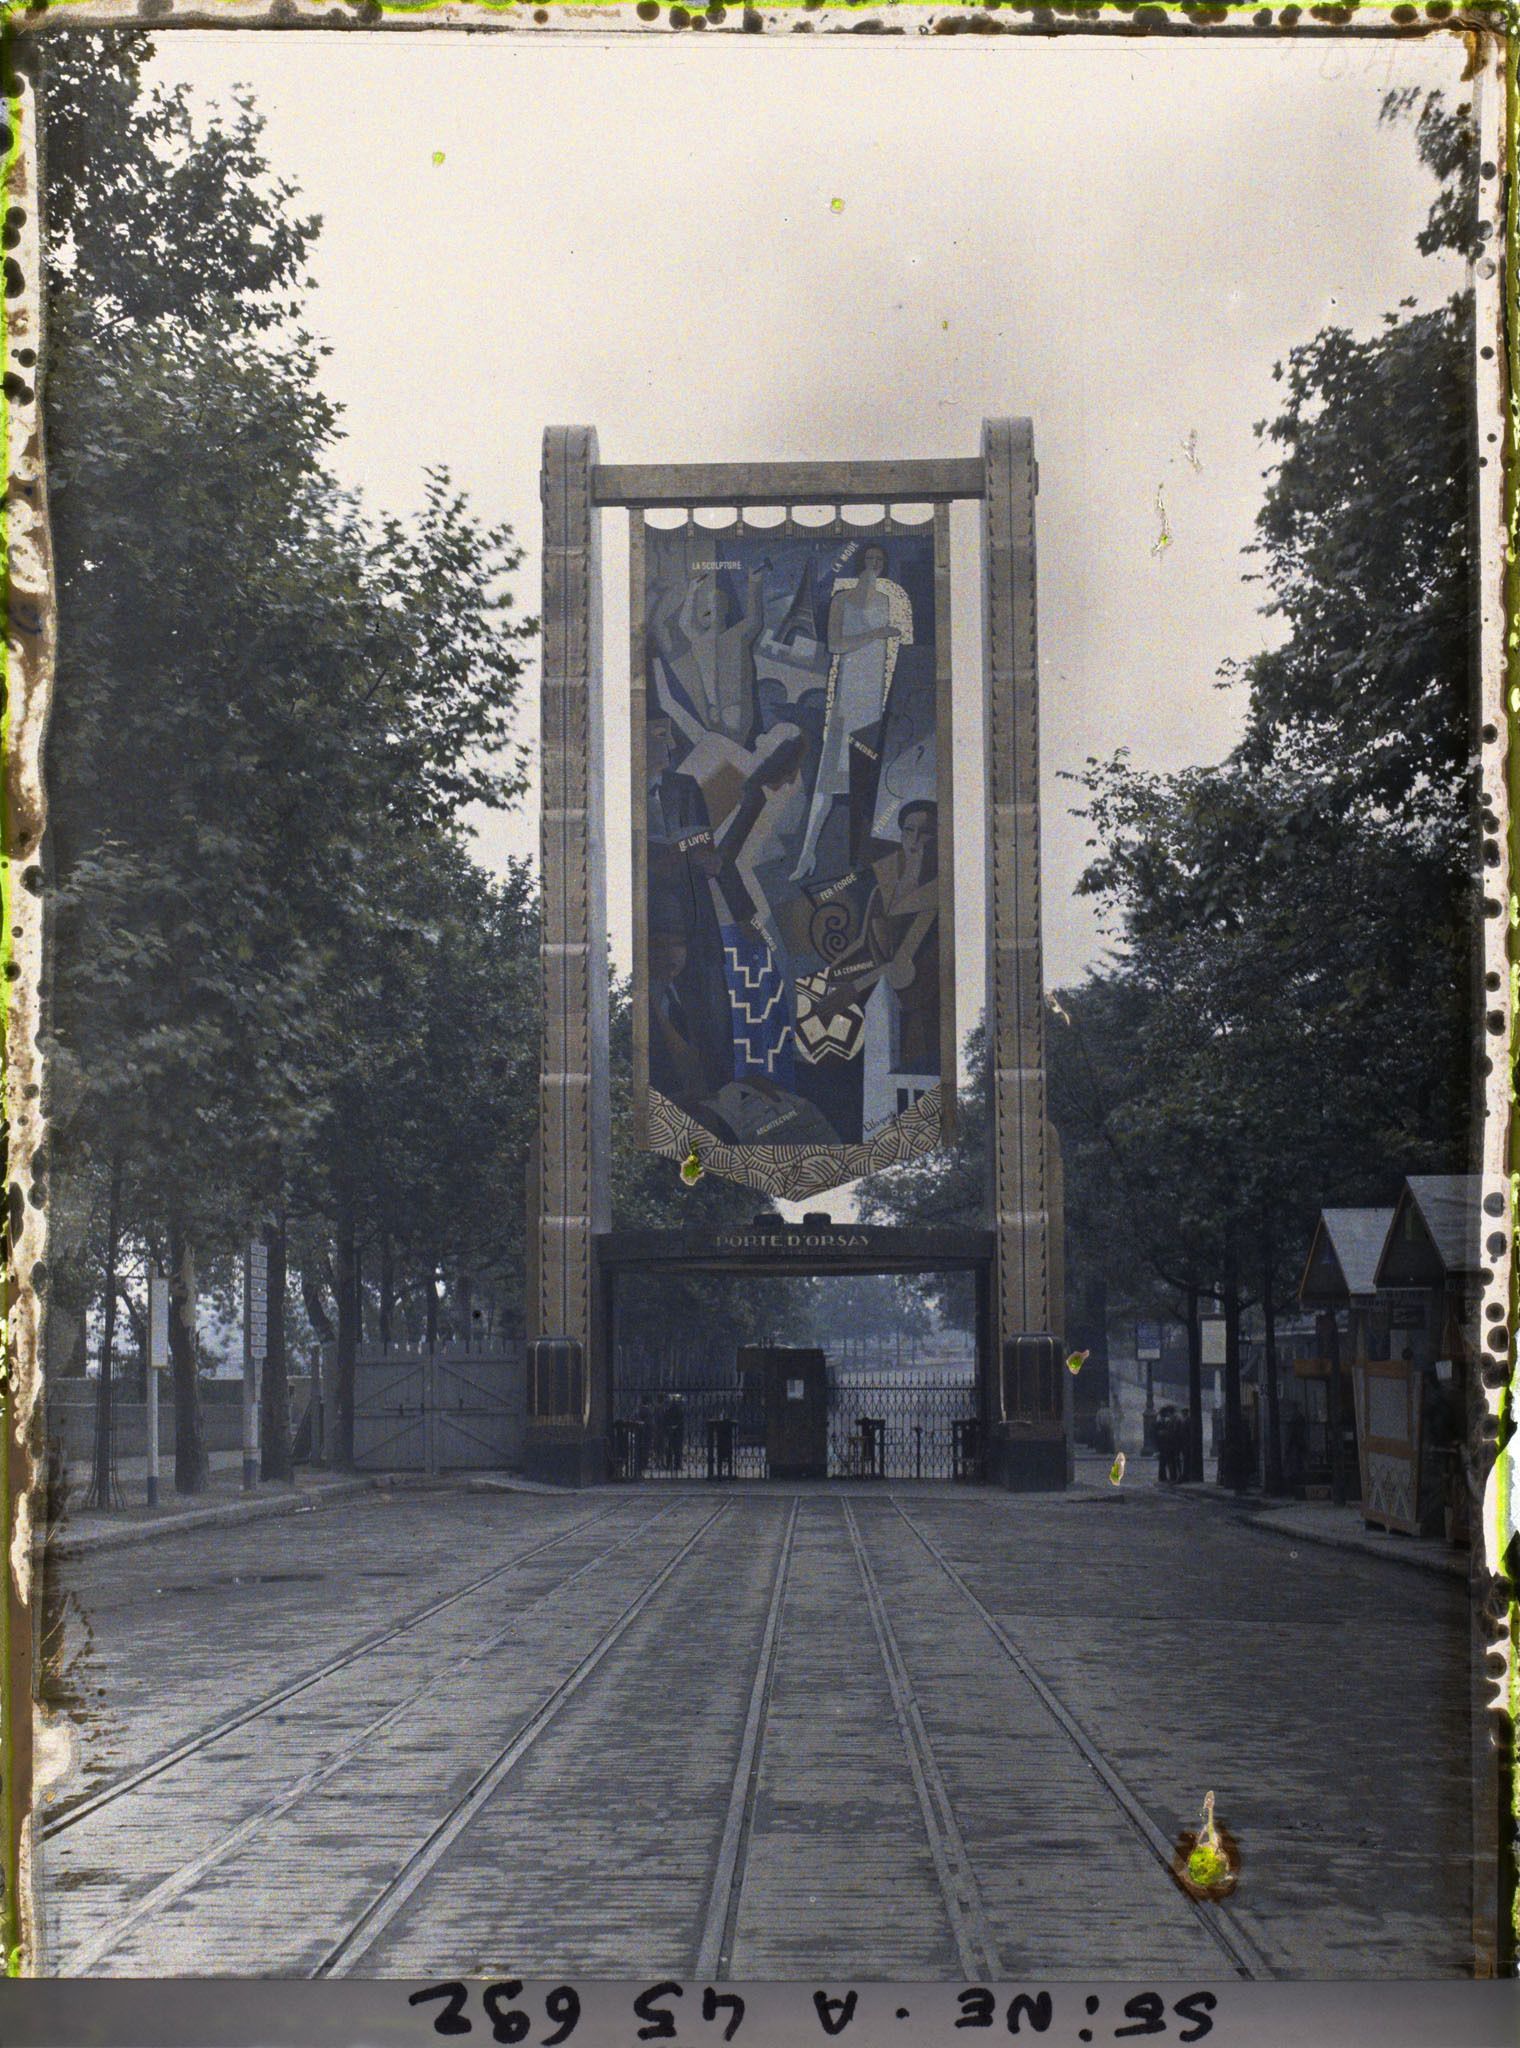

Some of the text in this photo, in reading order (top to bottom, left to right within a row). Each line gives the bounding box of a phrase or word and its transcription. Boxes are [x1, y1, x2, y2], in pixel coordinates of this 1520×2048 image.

[715, 1235, 870, 1248] PORTE D'ORSAY
[407, 1979, 583, 2047] 692
[633, 1979, 746, 2042] 45
[812, 1990, 859, 2036] A
